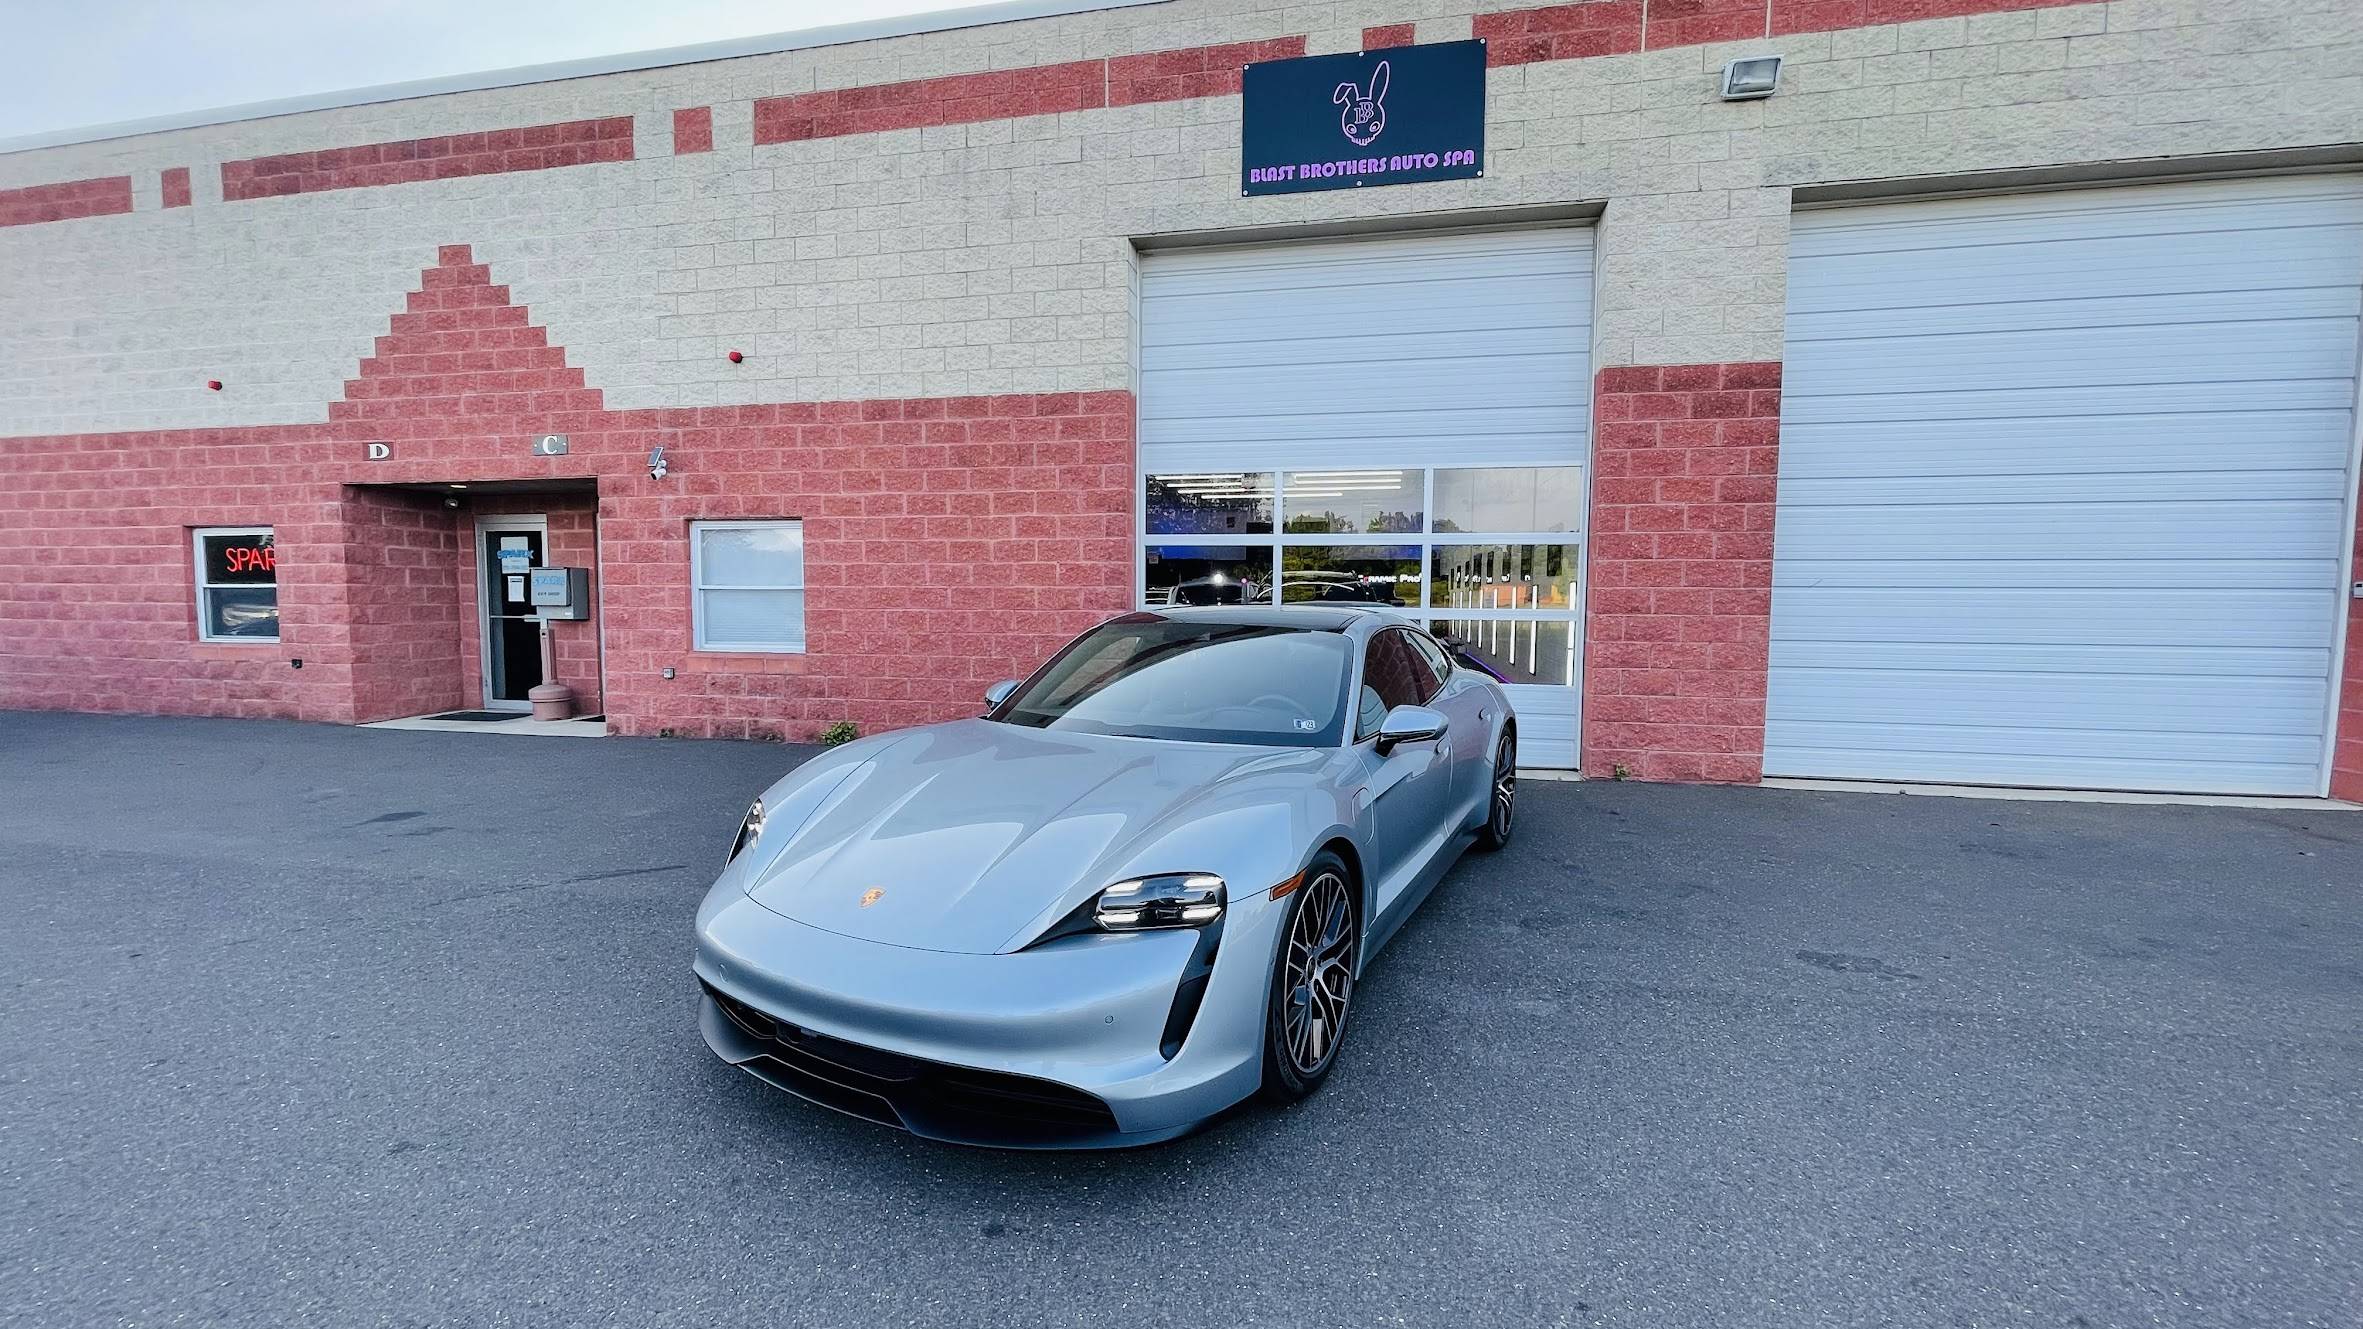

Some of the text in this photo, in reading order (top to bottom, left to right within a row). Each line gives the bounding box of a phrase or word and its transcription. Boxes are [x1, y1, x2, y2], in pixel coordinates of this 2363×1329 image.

[1250, 149, 1475, 183] BLAST BROTHERS AUTO SPA
[368, 443, 390, 459] D
[542, 435, 558, 455] C
